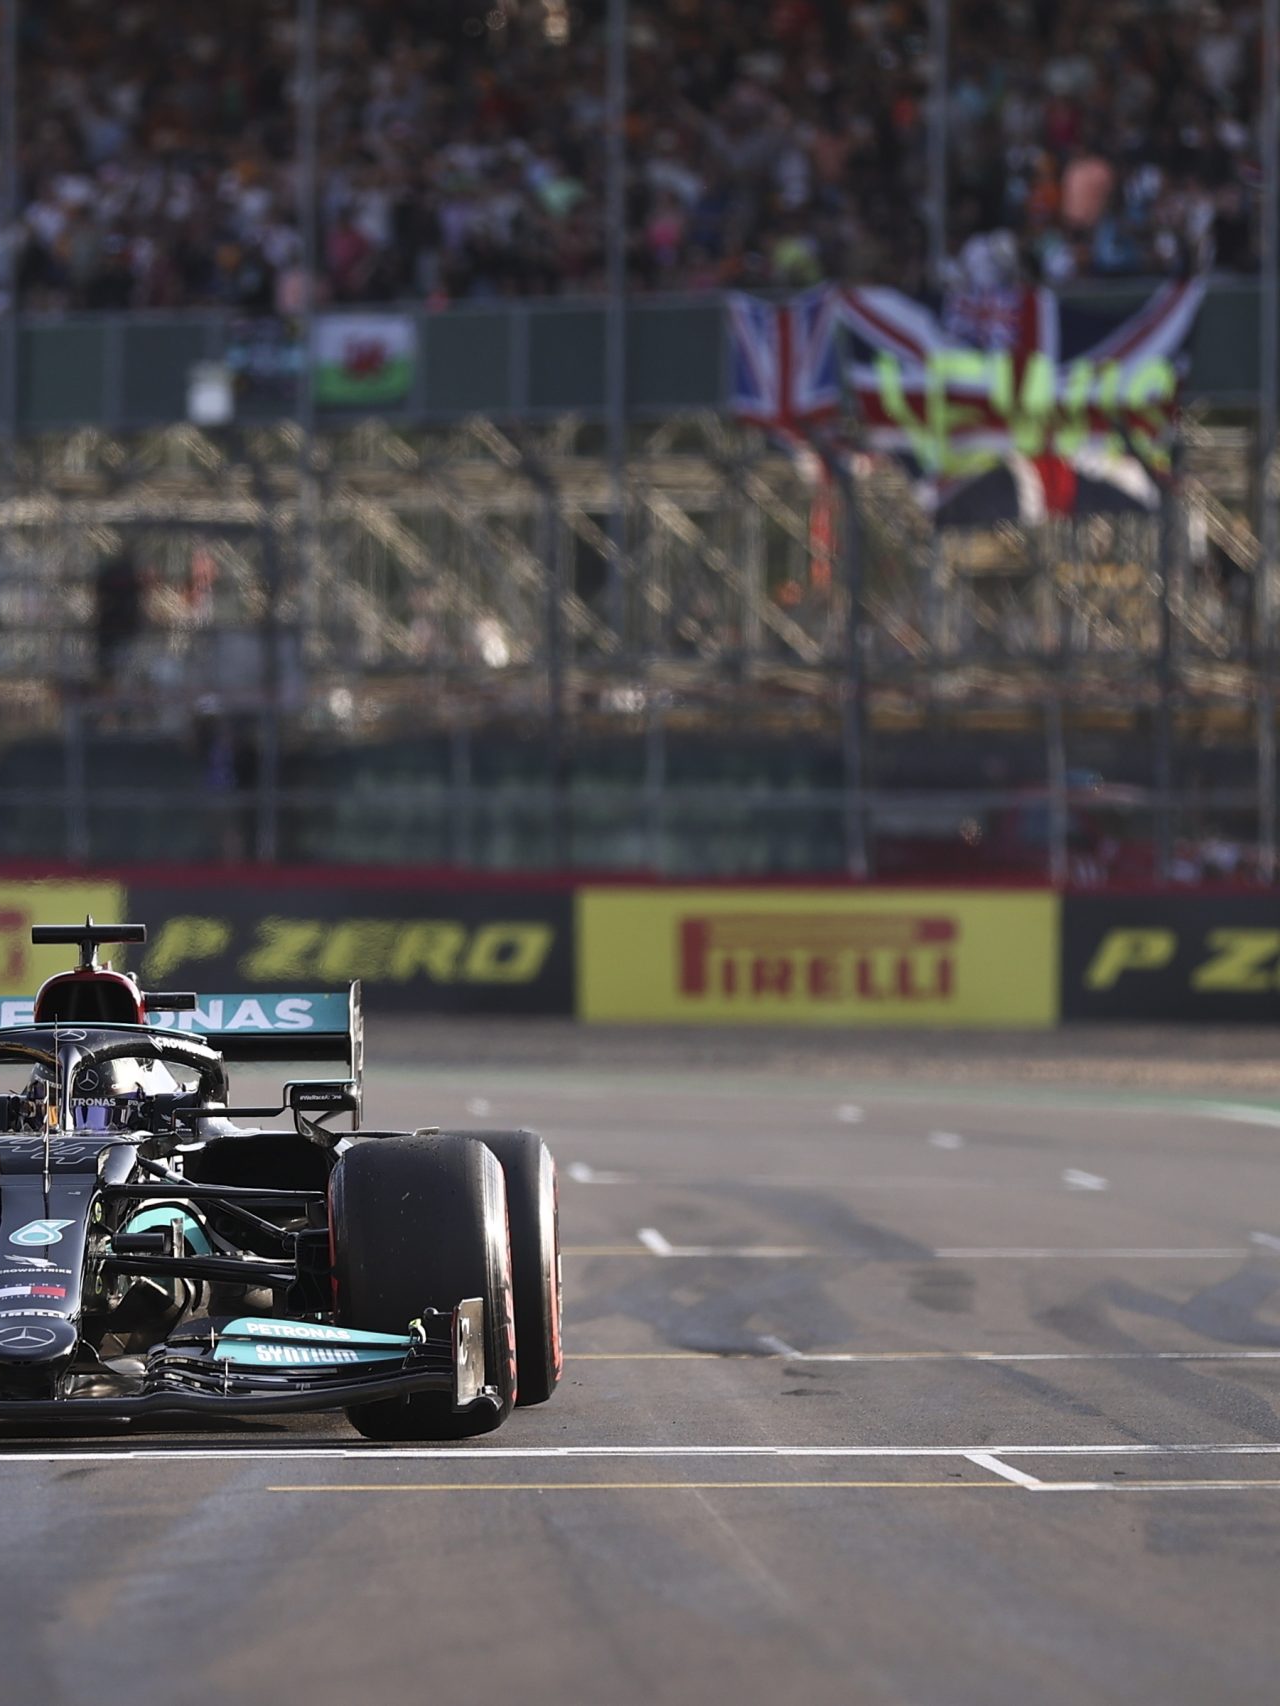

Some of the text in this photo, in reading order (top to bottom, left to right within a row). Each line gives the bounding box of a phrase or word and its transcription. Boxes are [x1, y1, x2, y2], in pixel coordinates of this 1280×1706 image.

[140, 915, 554, 984] P ZERO
[678, 915, 959, 1000] PIRELLI
[1088, 928, 1280, 992] P Z
[247, 1323, 351, 1340] PETRONAS
[256, 1344, 360, 1363] SYNTIUM
